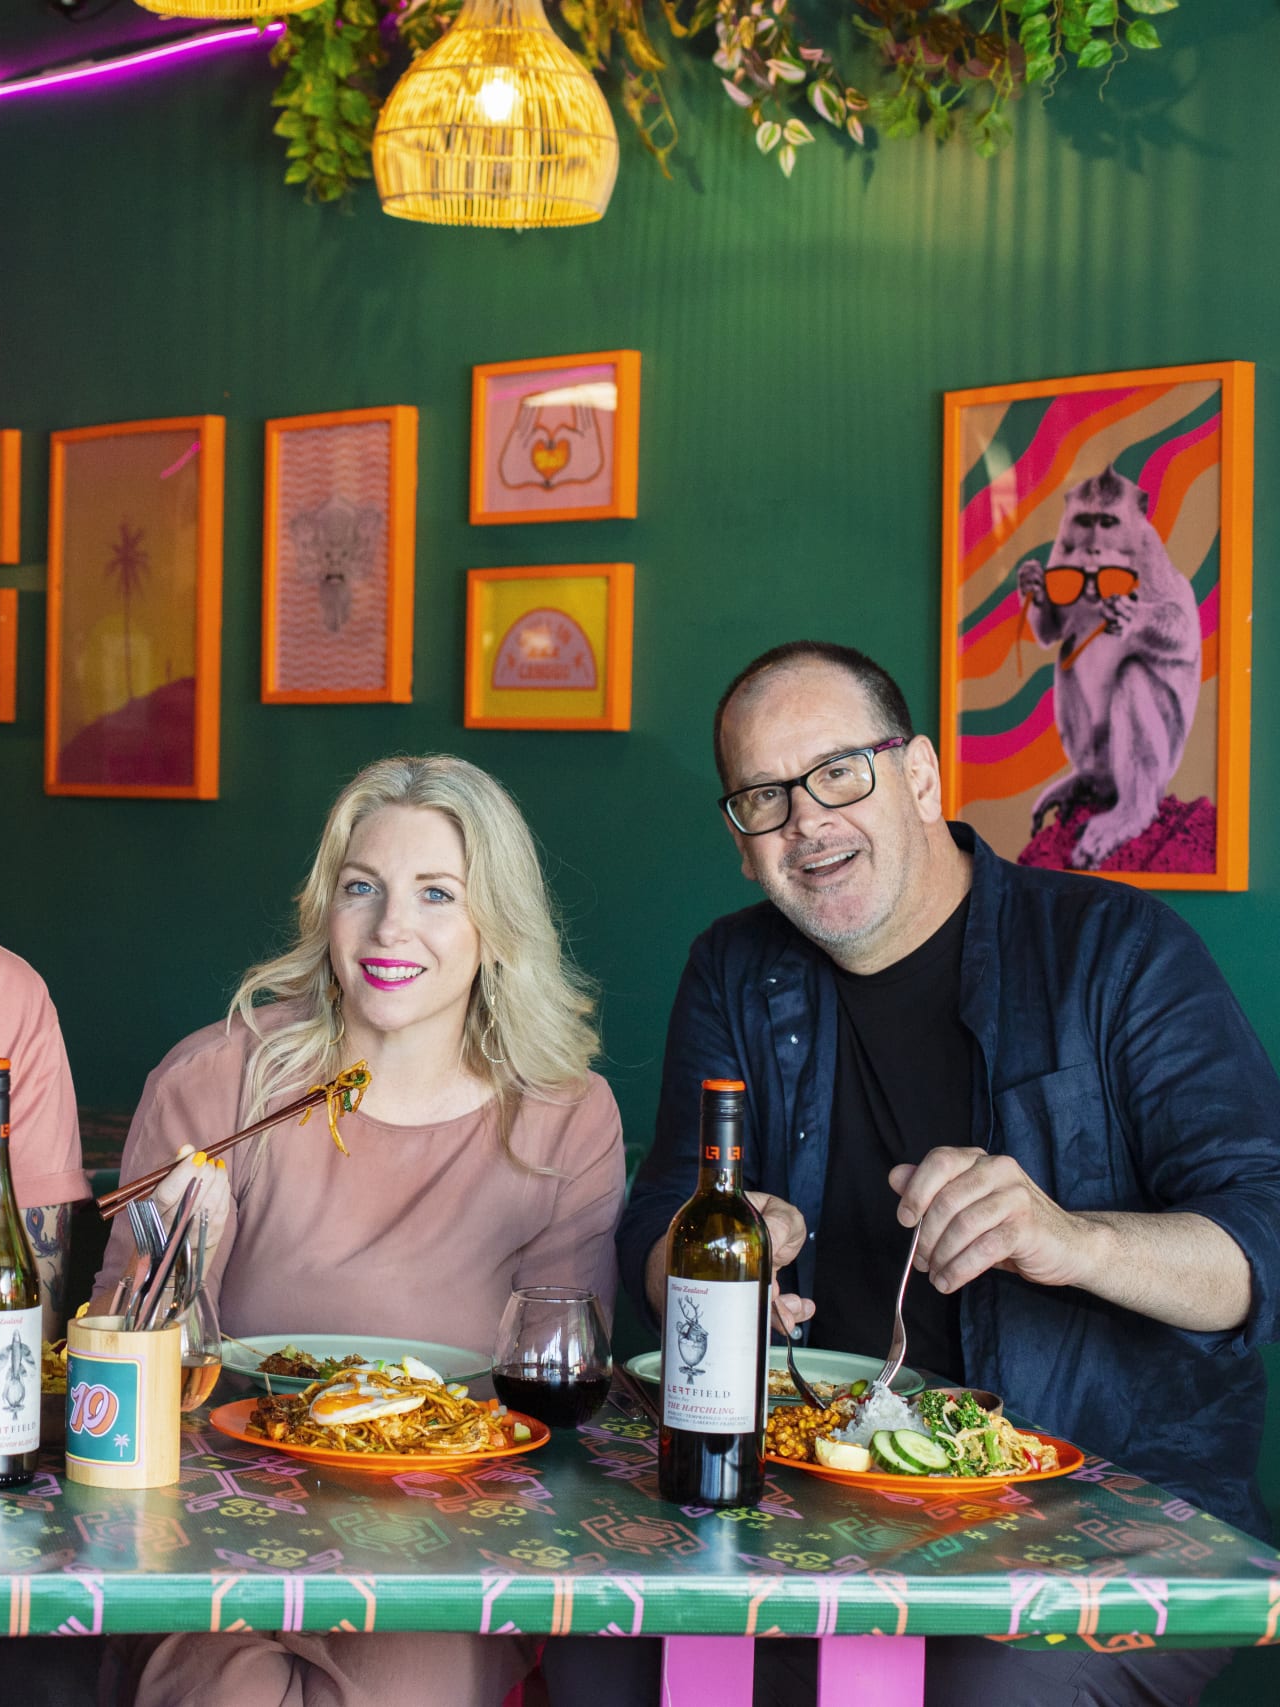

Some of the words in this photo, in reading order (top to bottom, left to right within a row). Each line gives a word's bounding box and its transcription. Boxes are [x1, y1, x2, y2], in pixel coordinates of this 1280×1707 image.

[683, 1285, 708, 1295] Zealand
[0, 1316, 24, 1325] Zealand
[70, 1381, 119, 1437] 10
[667, 1400, 681, 1410] THE
[682, 1403, 736, 1415] HATCHLING
